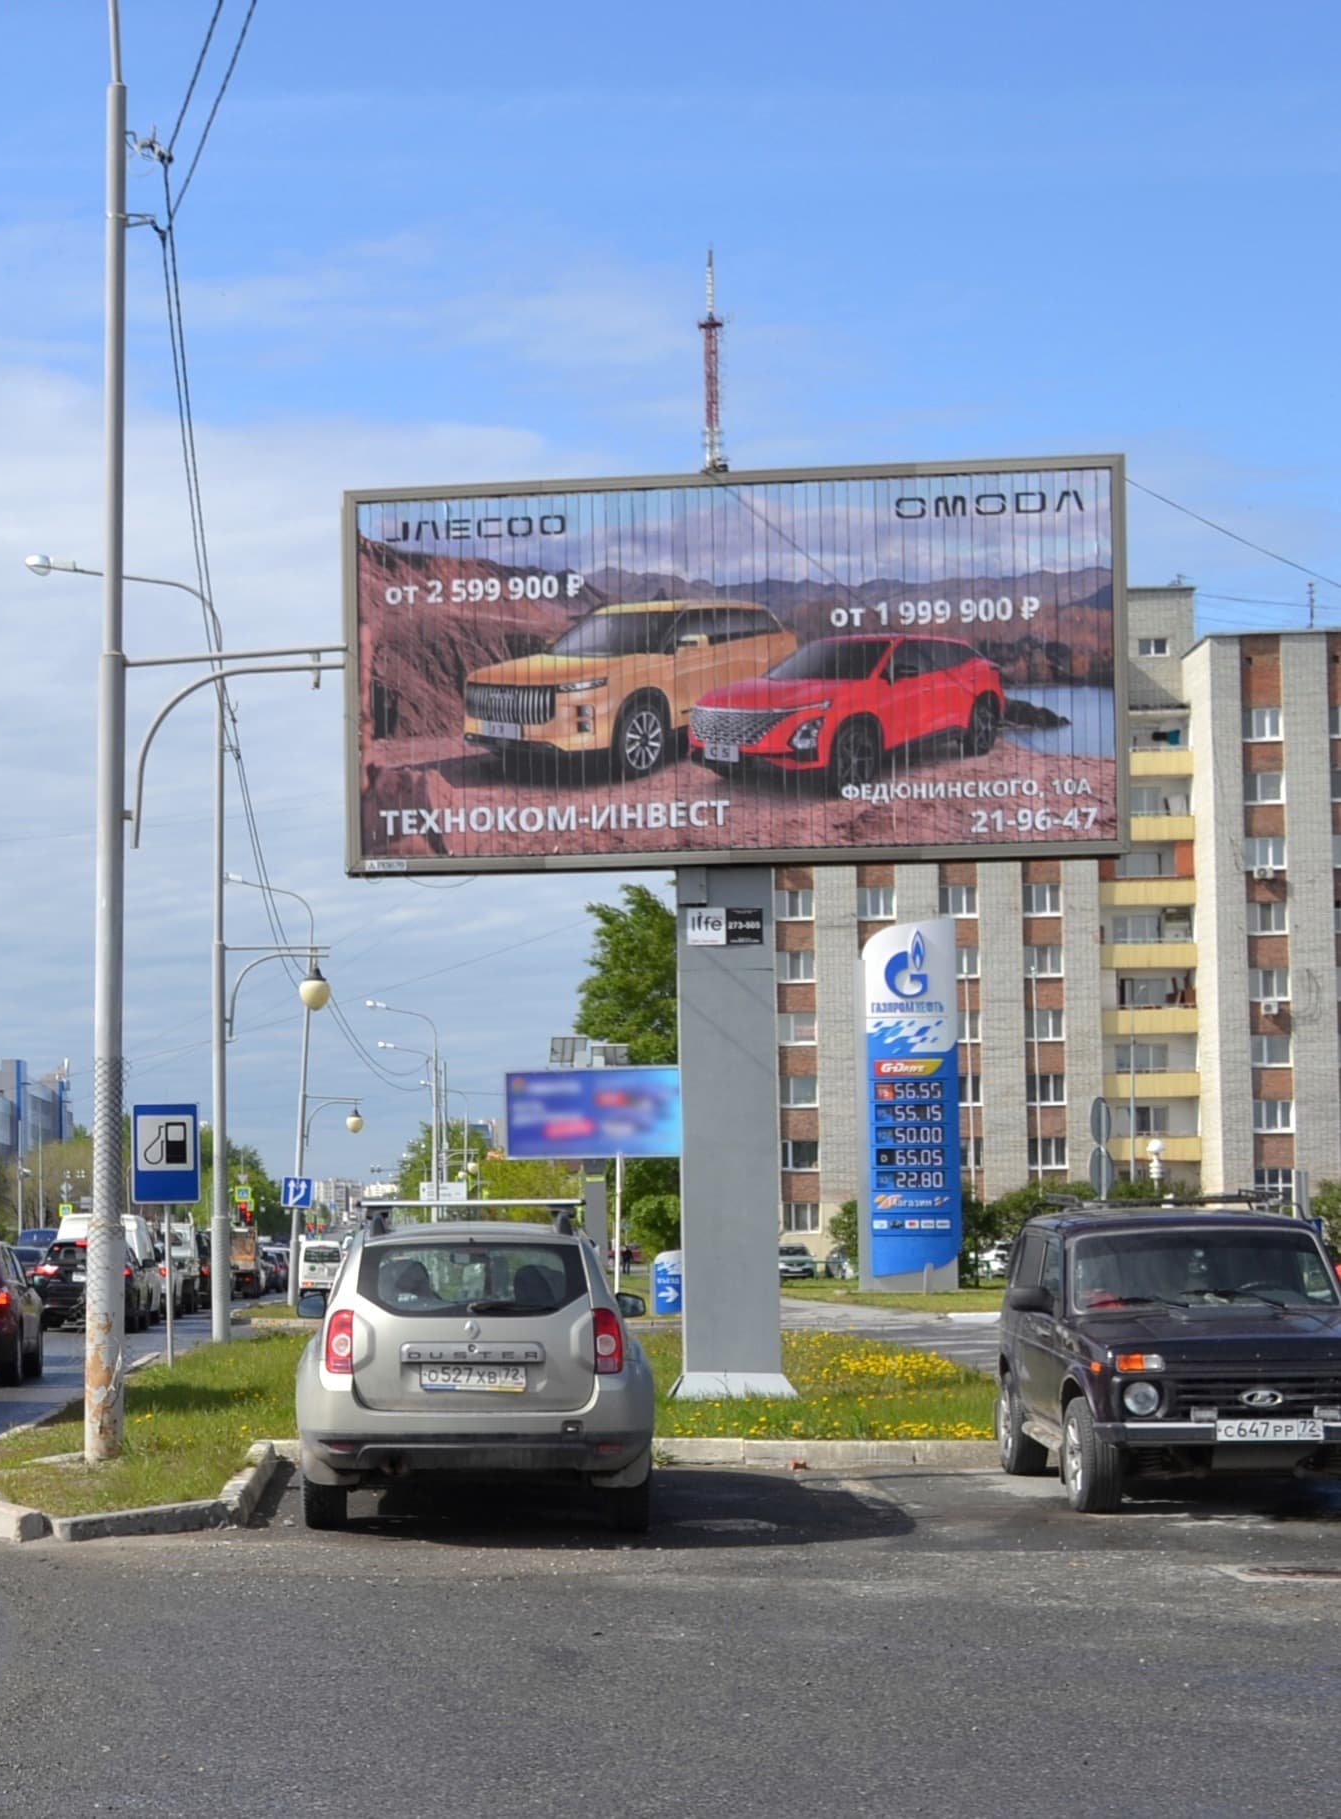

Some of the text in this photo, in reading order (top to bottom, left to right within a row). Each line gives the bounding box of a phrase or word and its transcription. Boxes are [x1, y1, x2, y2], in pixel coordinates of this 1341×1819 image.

[894, 490, 1085, 519] OMODA
[385, 514, 567, 543] JAECOO
[384, 585, 419, 605] от
[426, 579, 443, 604] 2
[451, 577, 501, 604] 599
[508, 575, 559, 600] 900
[830, 607, 866, 628] от
[874, 602, 889, 626] 1
[899, 600, 951, 625] 999
[960, 597, 1013, 624] 900
[841, 778, 1045, 805] ФЕДЮНИНСКОГО,
[379, 800, 731, 837] ТЕХНОКОМ-ИНВЕСТ
[970, 807, 1098, 834] 21-96-47
[894, 1082, 942, 1099] 56.55
[895, 1127, 943, 1144] 50.00
[895, 1149, 943, 1166] 65.05
[896, 1172, 944, 1188] 22.80
[408, 1351, 539, 1360] DUSTER
